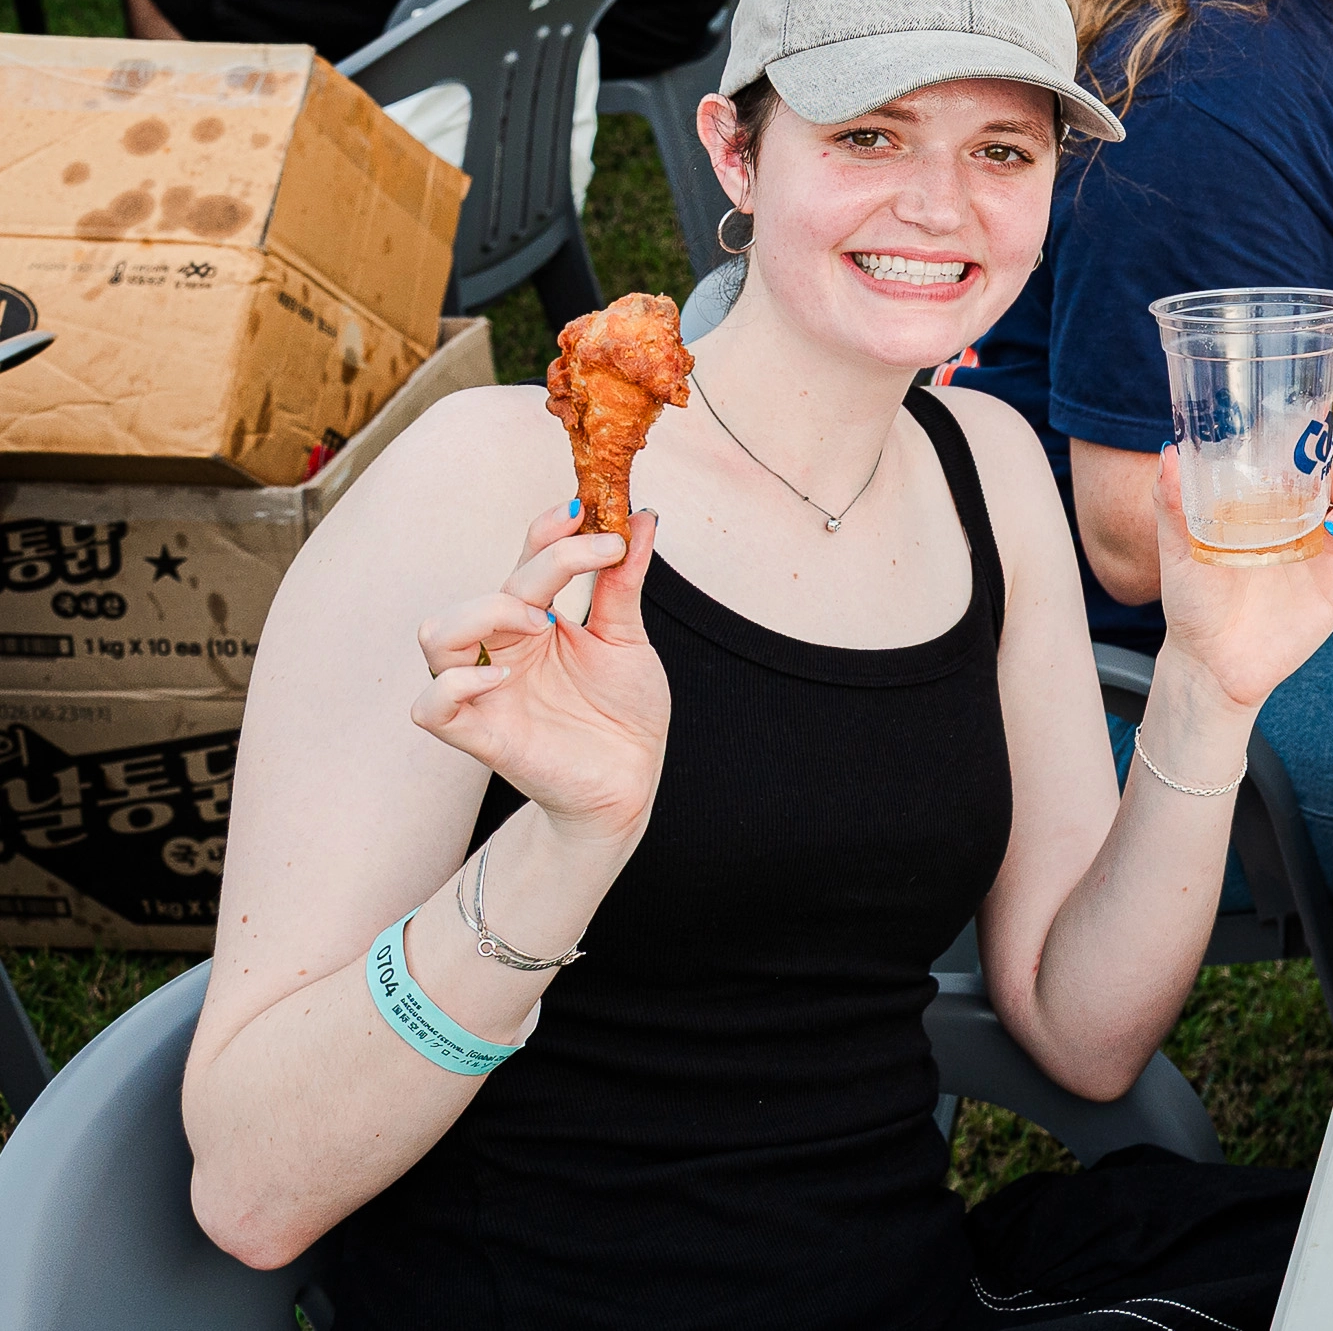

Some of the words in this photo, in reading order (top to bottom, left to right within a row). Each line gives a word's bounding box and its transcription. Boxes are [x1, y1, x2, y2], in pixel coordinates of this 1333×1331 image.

[100, 636, 125, 659] kg
[149, 638, 171, 656] 10
[175, 642, 201, 656] ea
[376, 944, 400, 998] 0704
